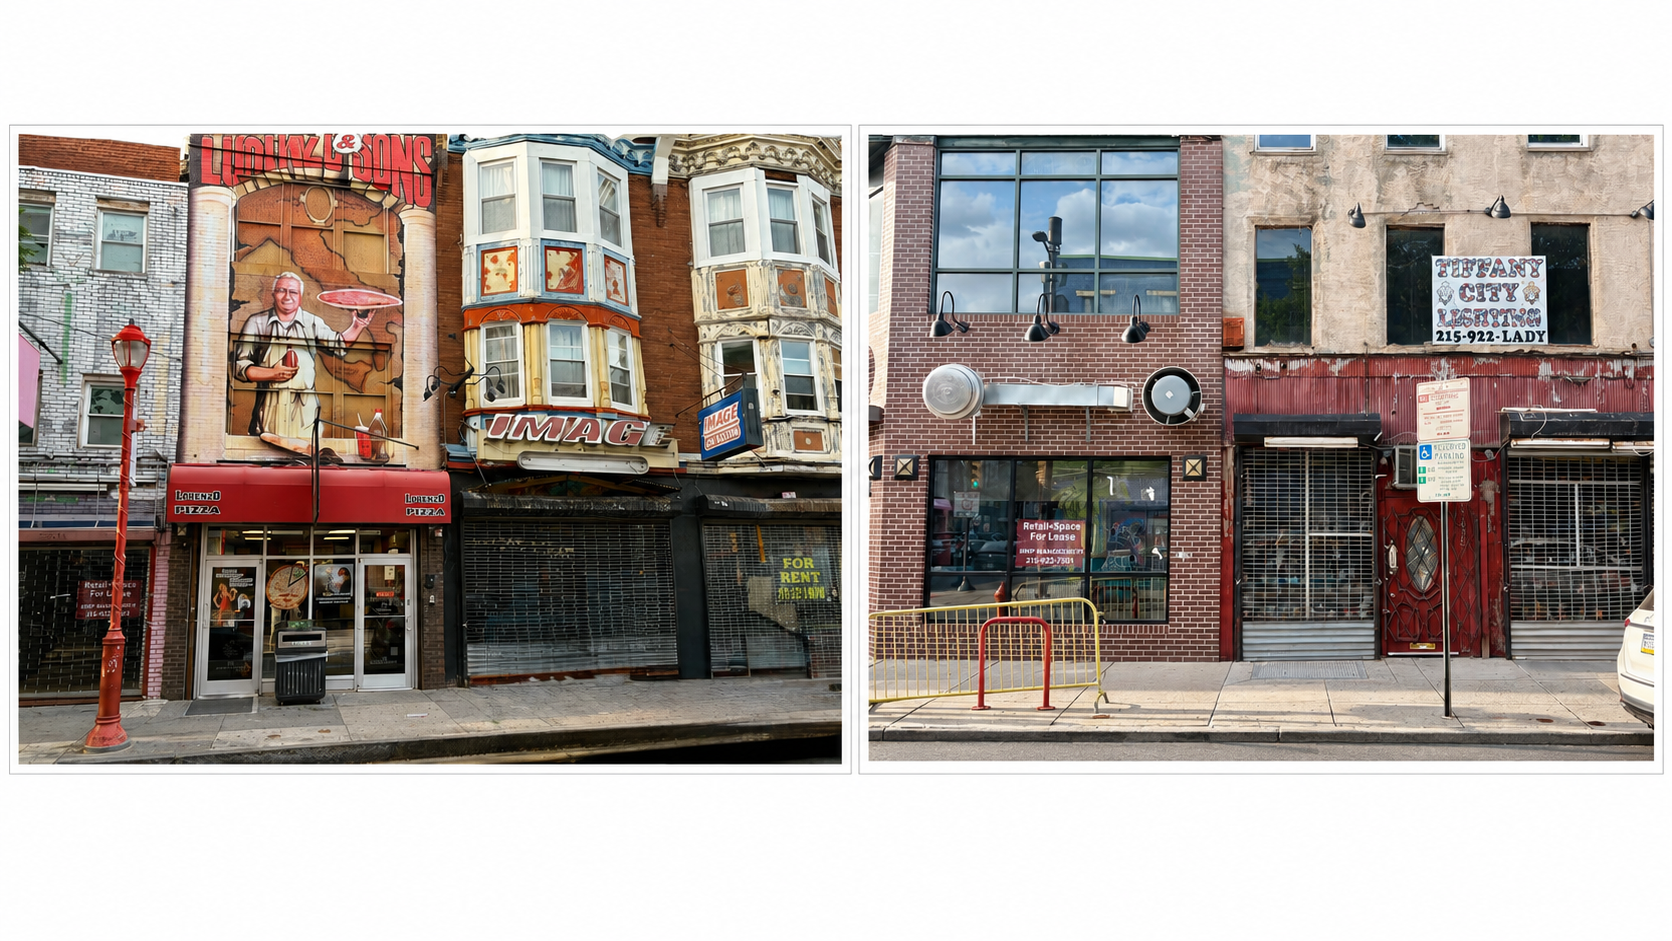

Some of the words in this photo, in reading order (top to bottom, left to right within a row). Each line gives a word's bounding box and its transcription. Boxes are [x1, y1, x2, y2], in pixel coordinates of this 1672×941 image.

[336, 134, 356, 149] &
[353, 134, 432, 208] SONS
[1435, 258, 1544, 278] TIFFANY
[1459, 283, 1519, 302] CITY
[704, 402, 739, 434] IMAGE
[174, 505, 221, 515] PIZZA
[1030, 532, 1046, 541] For
[783, 557, 815, 569] FOR
[780, 571, 821, 583] RENT
